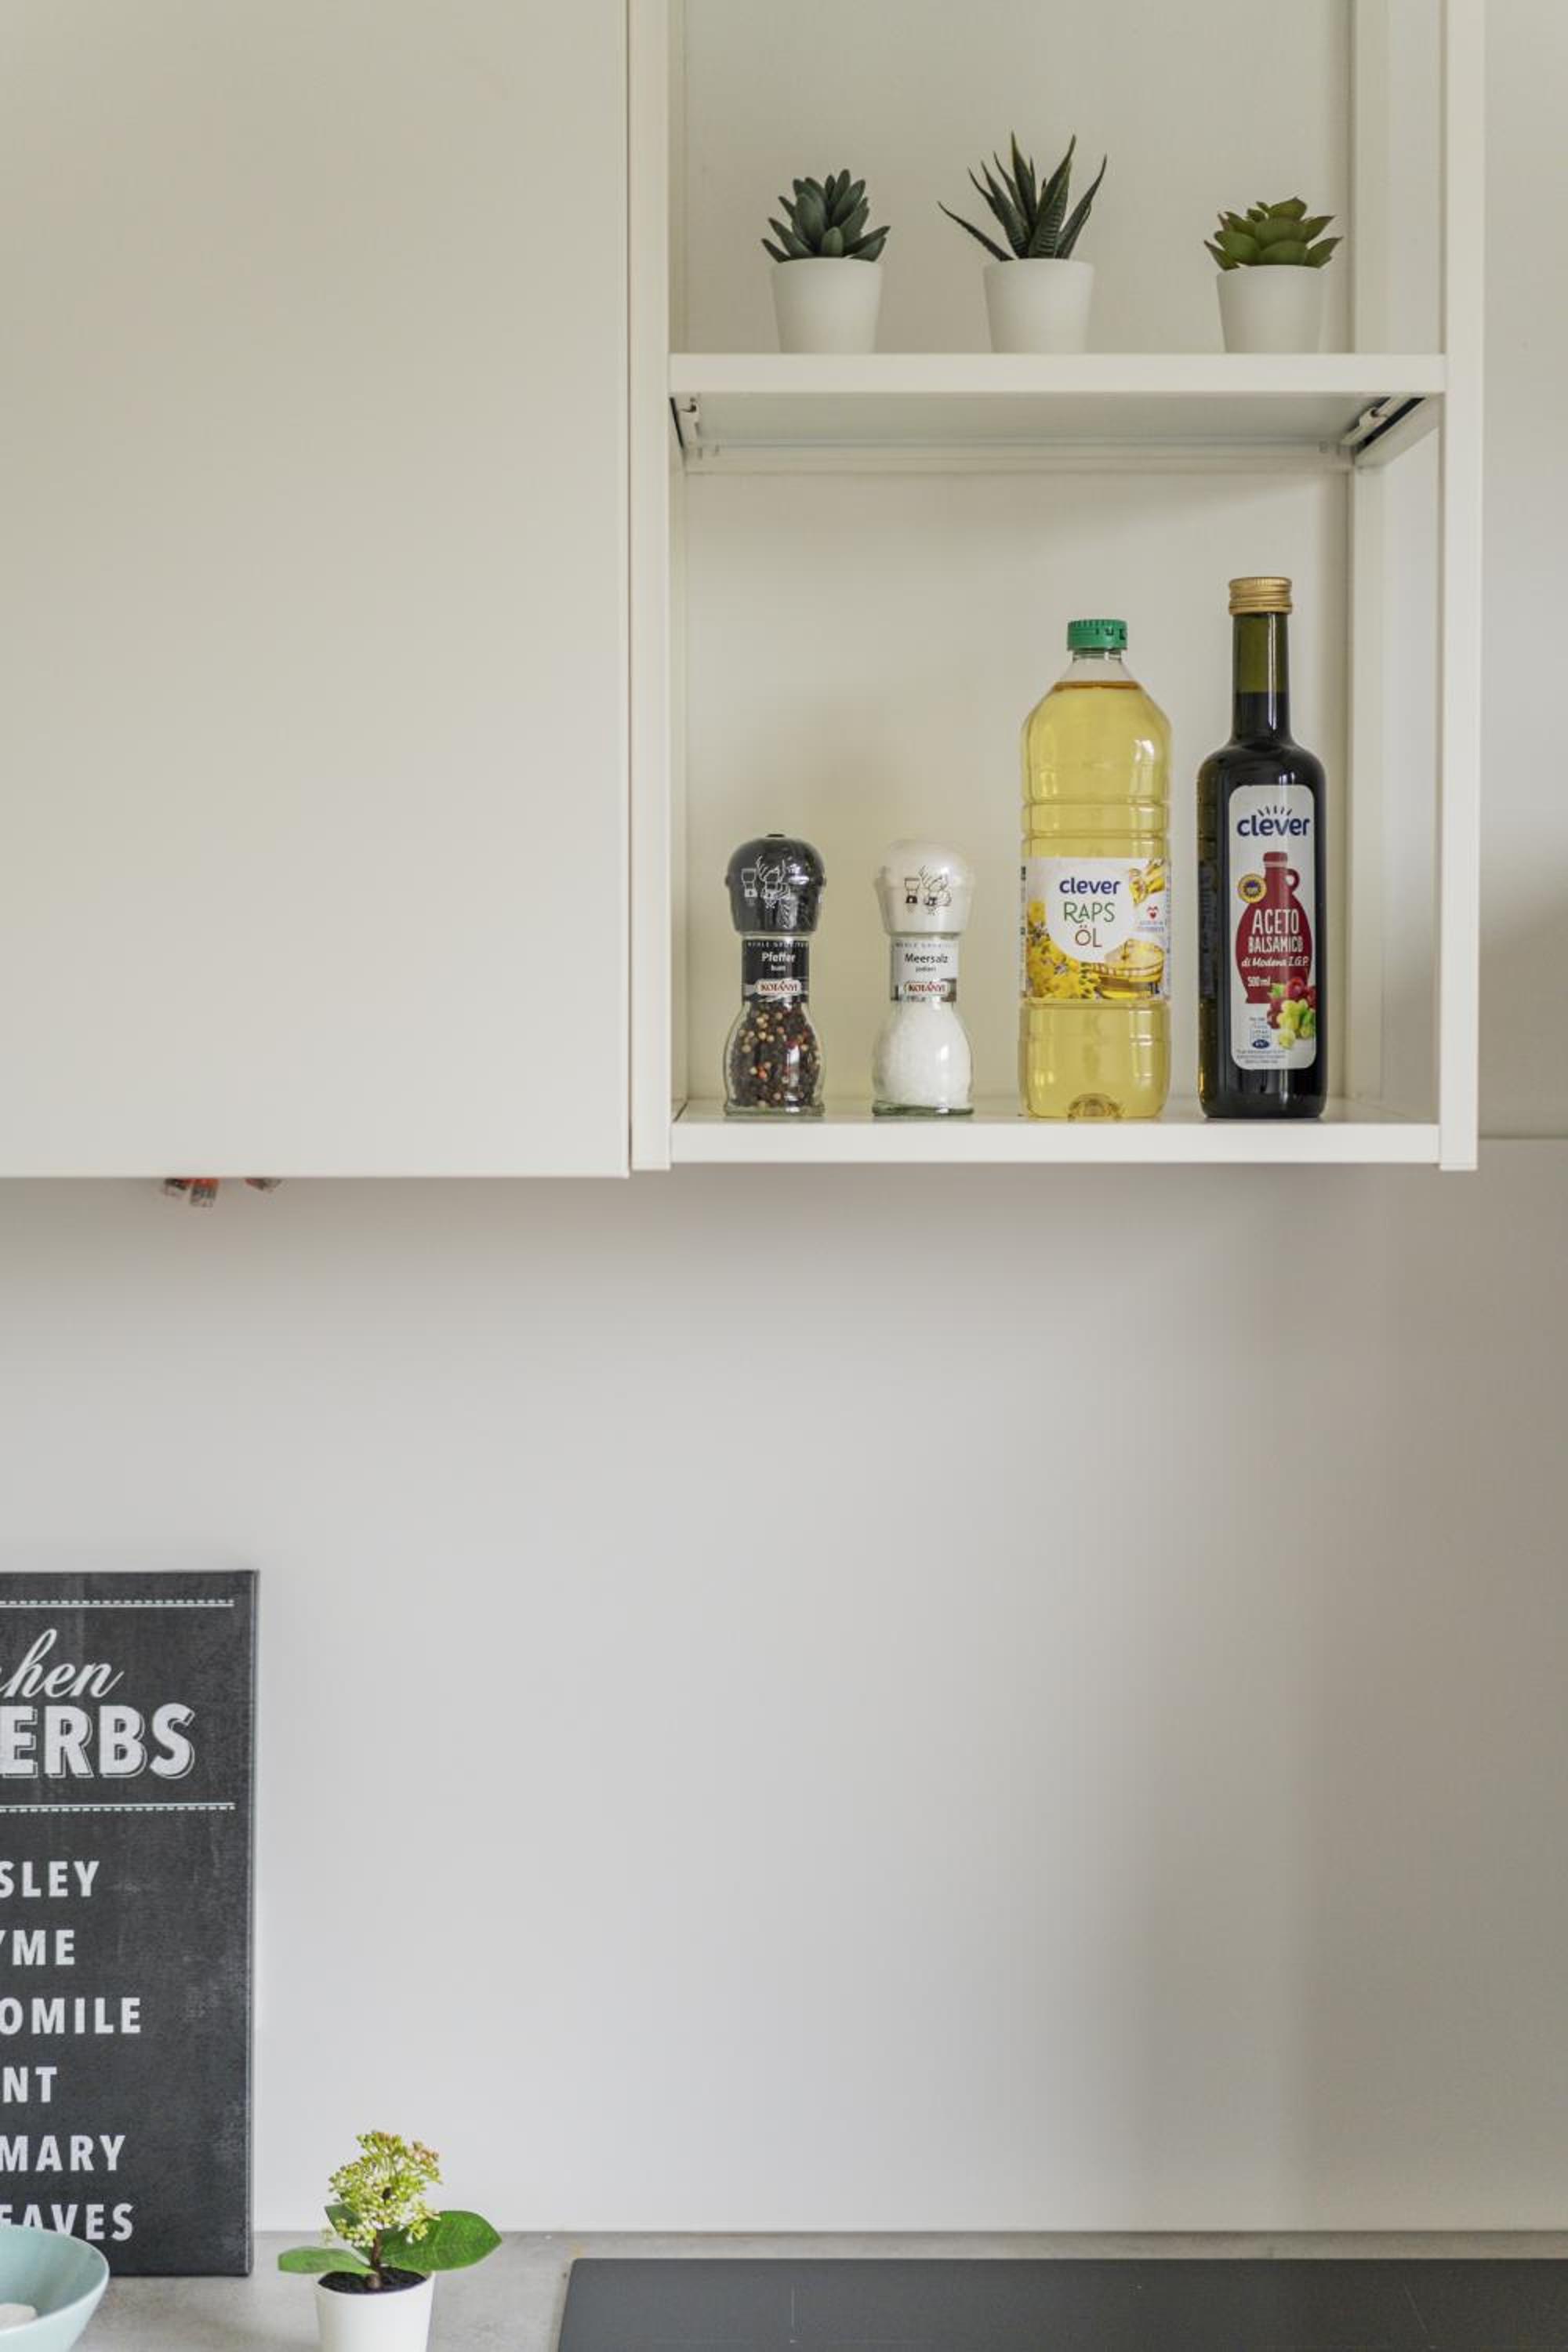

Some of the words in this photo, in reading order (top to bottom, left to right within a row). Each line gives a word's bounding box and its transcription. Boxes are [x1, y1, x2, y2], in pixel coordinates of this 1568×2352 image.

[1237, 815, 1310, 837] clever
[1059, 877, 1121, 895] clever
[1063, 901, 1116, 924] RAPS
[1252, 909, 1299, 935] ACETO
[1075, 924, 1102, 948] ÖL
[1248, 936, 1304, 953] BALSAMICO
[761, 951, 796, 962] Pfeffer
[904, 953, 948, 964] Meersalz
[0, 1628, 125, 1698] hen
[0, 1702, 195, 1780] ERBS
[0, 1860, 100, 1898] SLEY
[0, 1929, 74, 1965] ME
[0, 1998, 141, 2034] OMILE
[3, 2067, 57, 2103] NT
[0, 2135, 125, 2172] MARY
